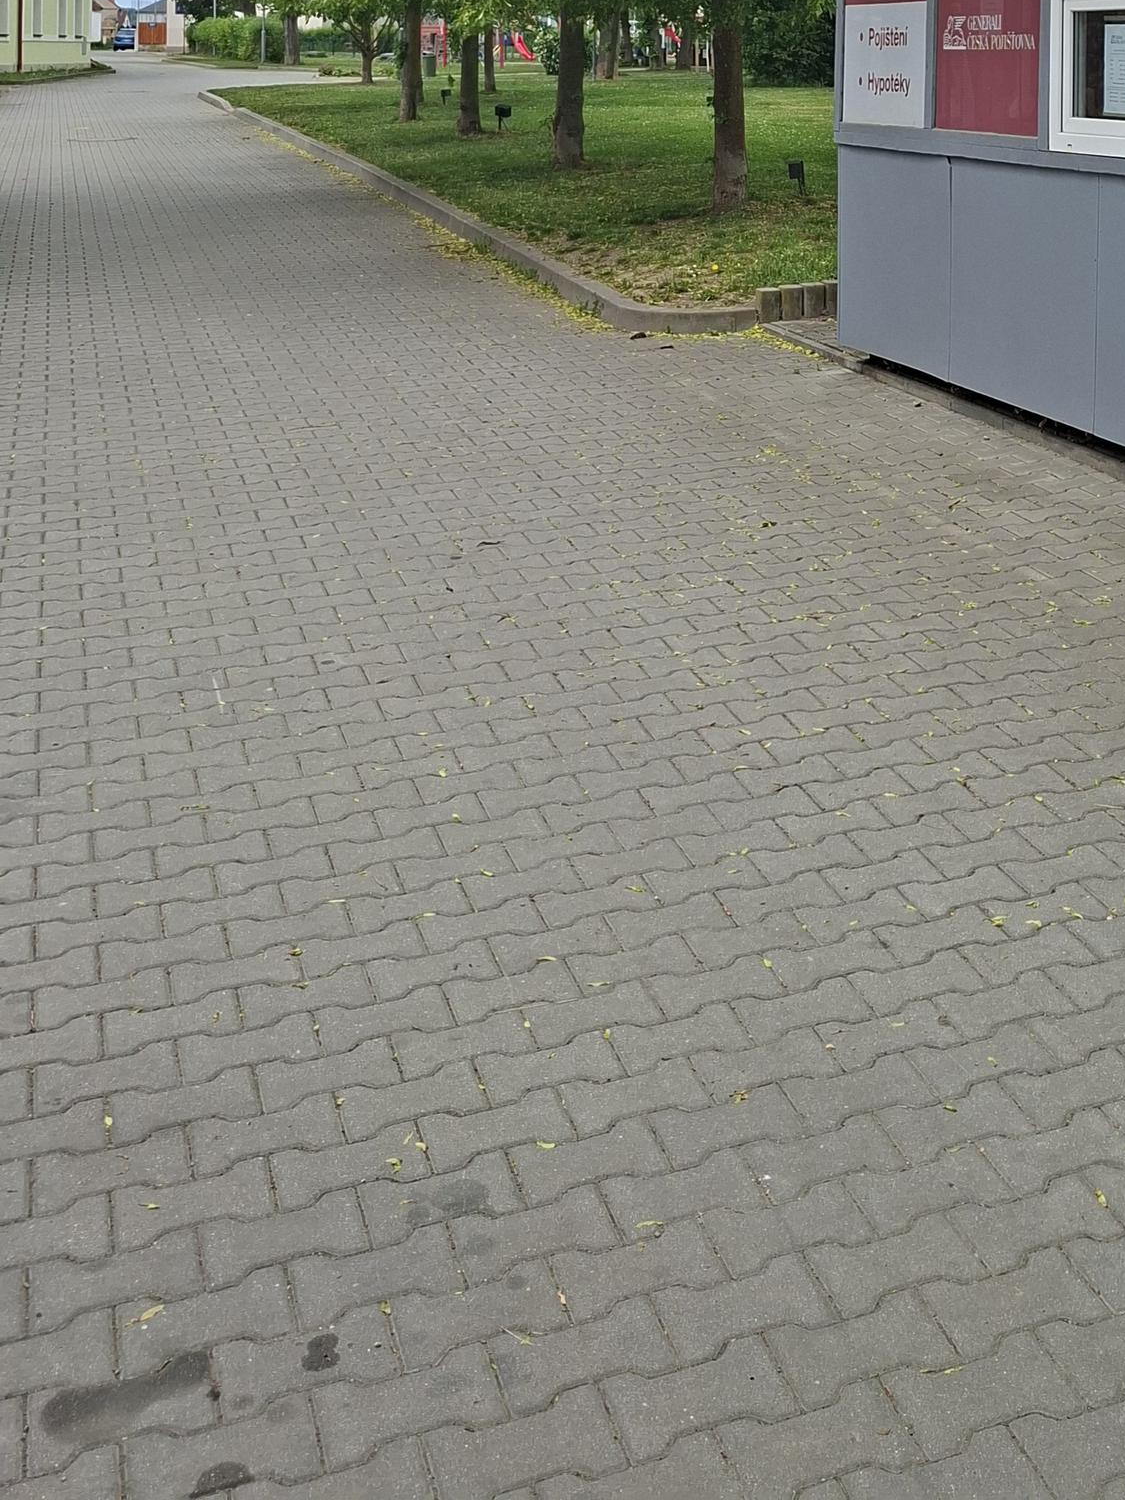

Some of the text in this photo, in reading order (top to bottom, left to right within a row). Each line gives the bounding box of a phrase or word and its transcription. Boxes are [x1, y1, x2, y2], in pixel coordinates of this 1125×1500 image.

[967, 14, 1002, 31] GENERALI
[868, 26, 909, 51] Pojištění
[967, 31, 1036, 50] ČESKÁ POJIŠŤOVNA
[867, 72, 911, 97] Hypotéky
